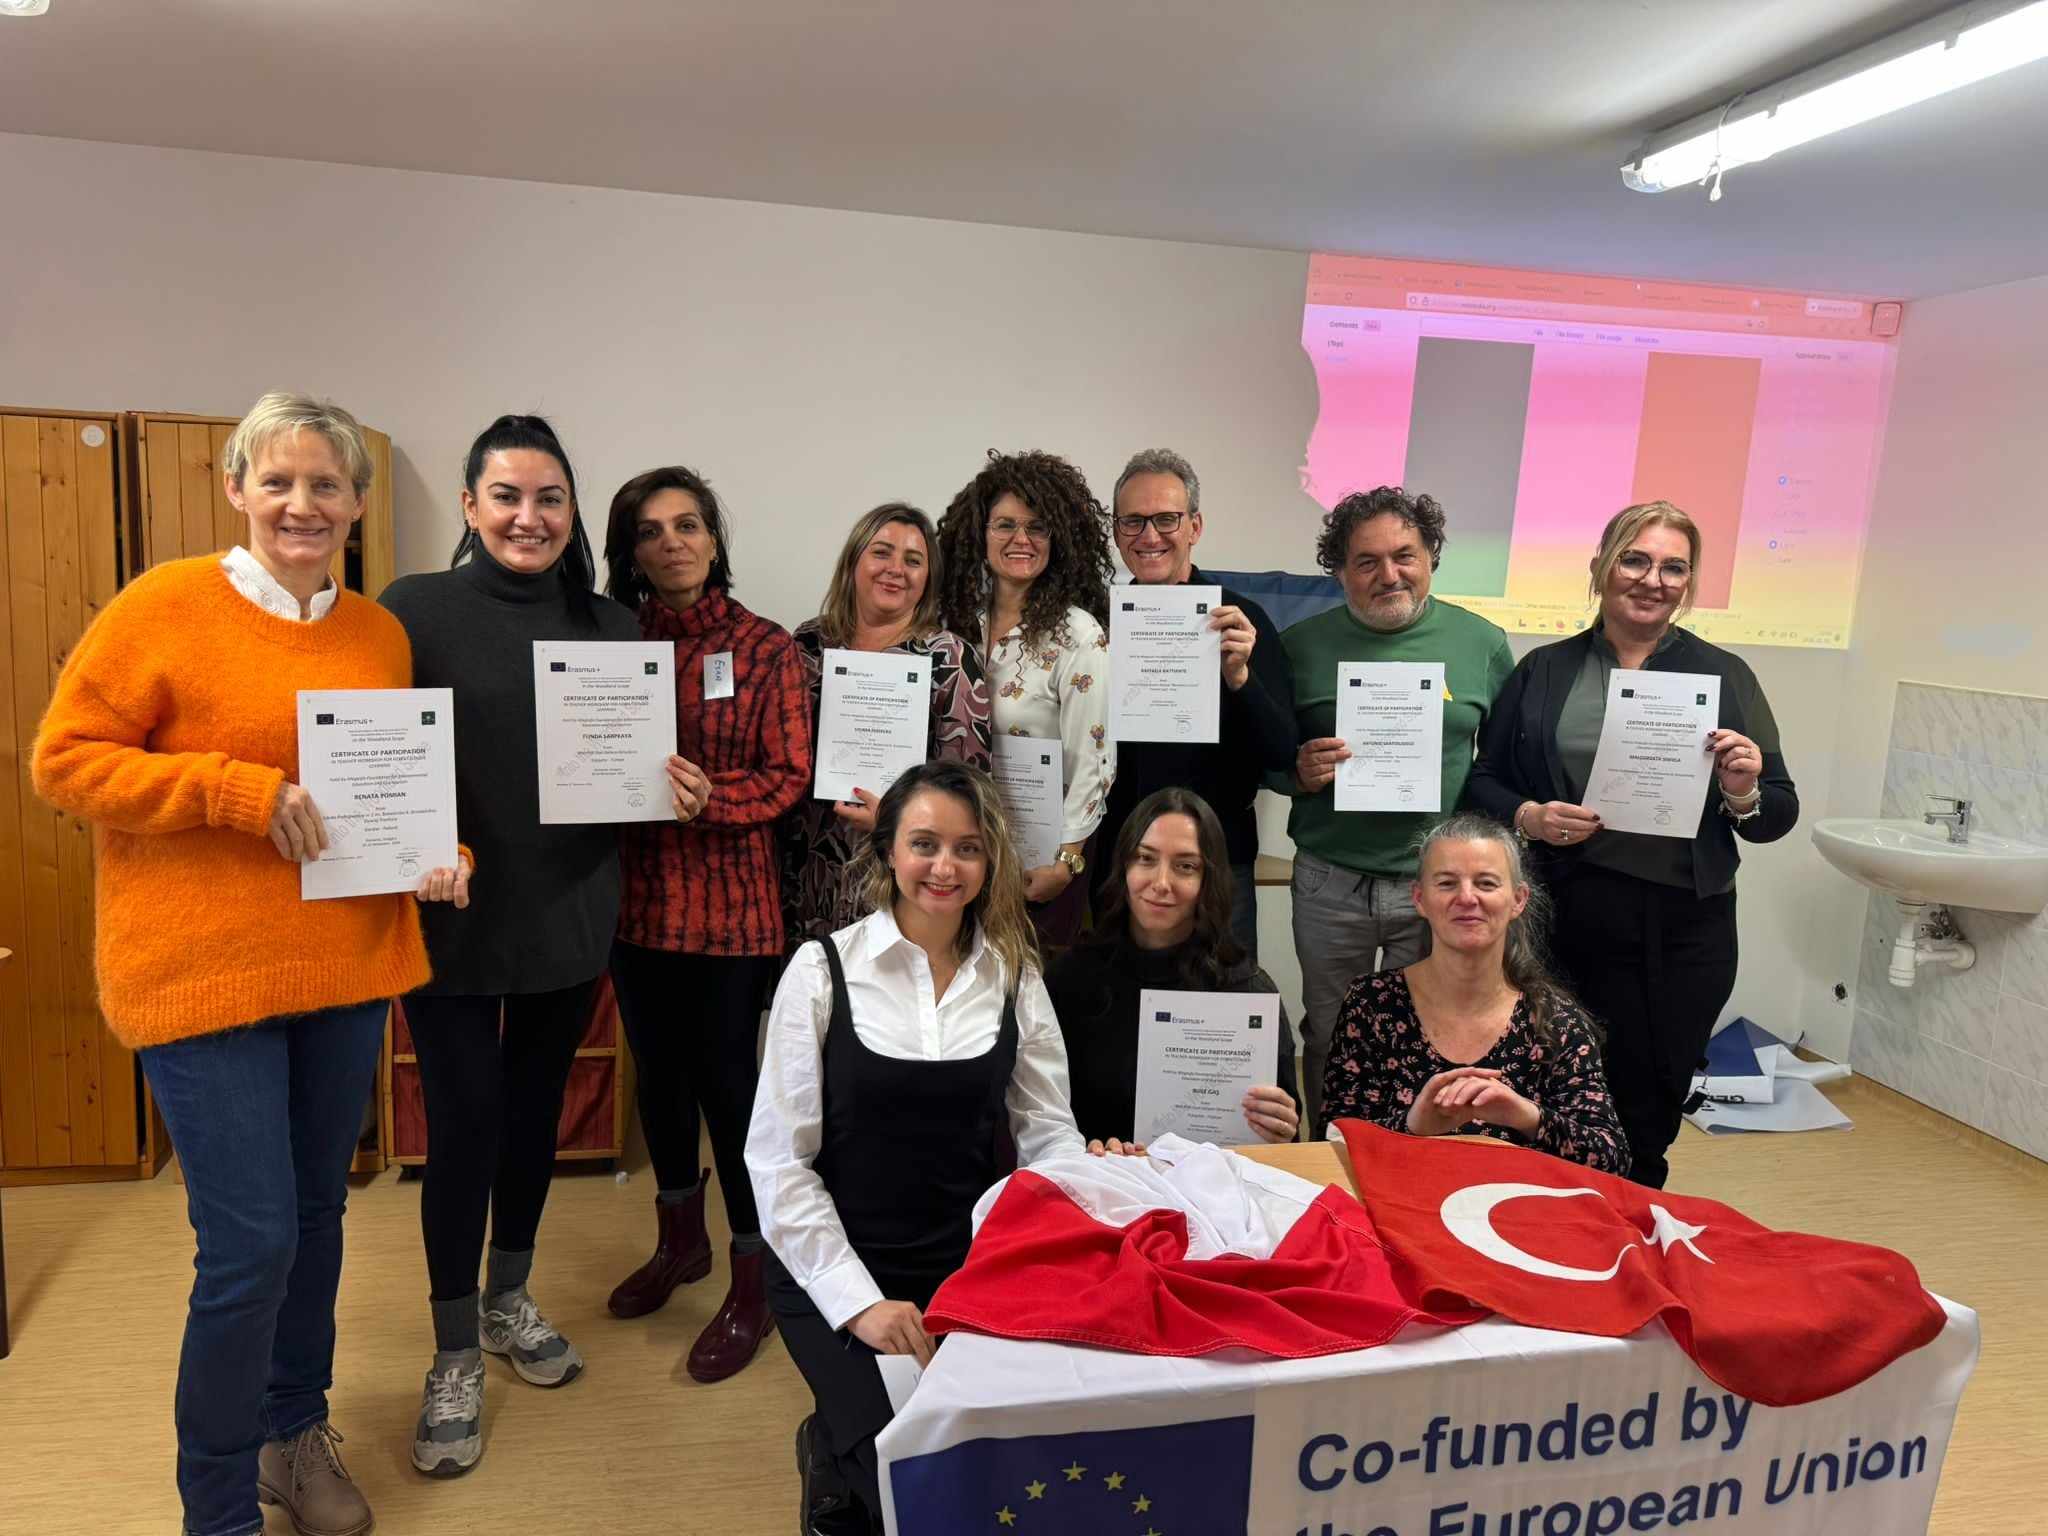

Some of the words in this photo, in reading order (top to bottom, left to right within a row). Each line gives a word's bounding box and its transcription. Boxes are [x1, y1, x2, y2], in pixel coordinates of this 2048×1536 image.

[380, 748, 426, 756] PARTICIPATION
[1165, 1046, 1199, 1055] CERTIFICATE
[1208, 1049, 1251, 1057] PARTICIPATION
[1298, 1392, 1659, 1492] Co-funded
[1681, 1386, 1752, 1451] by
[1429, 1477, 1743, 1536] European
[1764, 1435, 1928, 1505] Union
